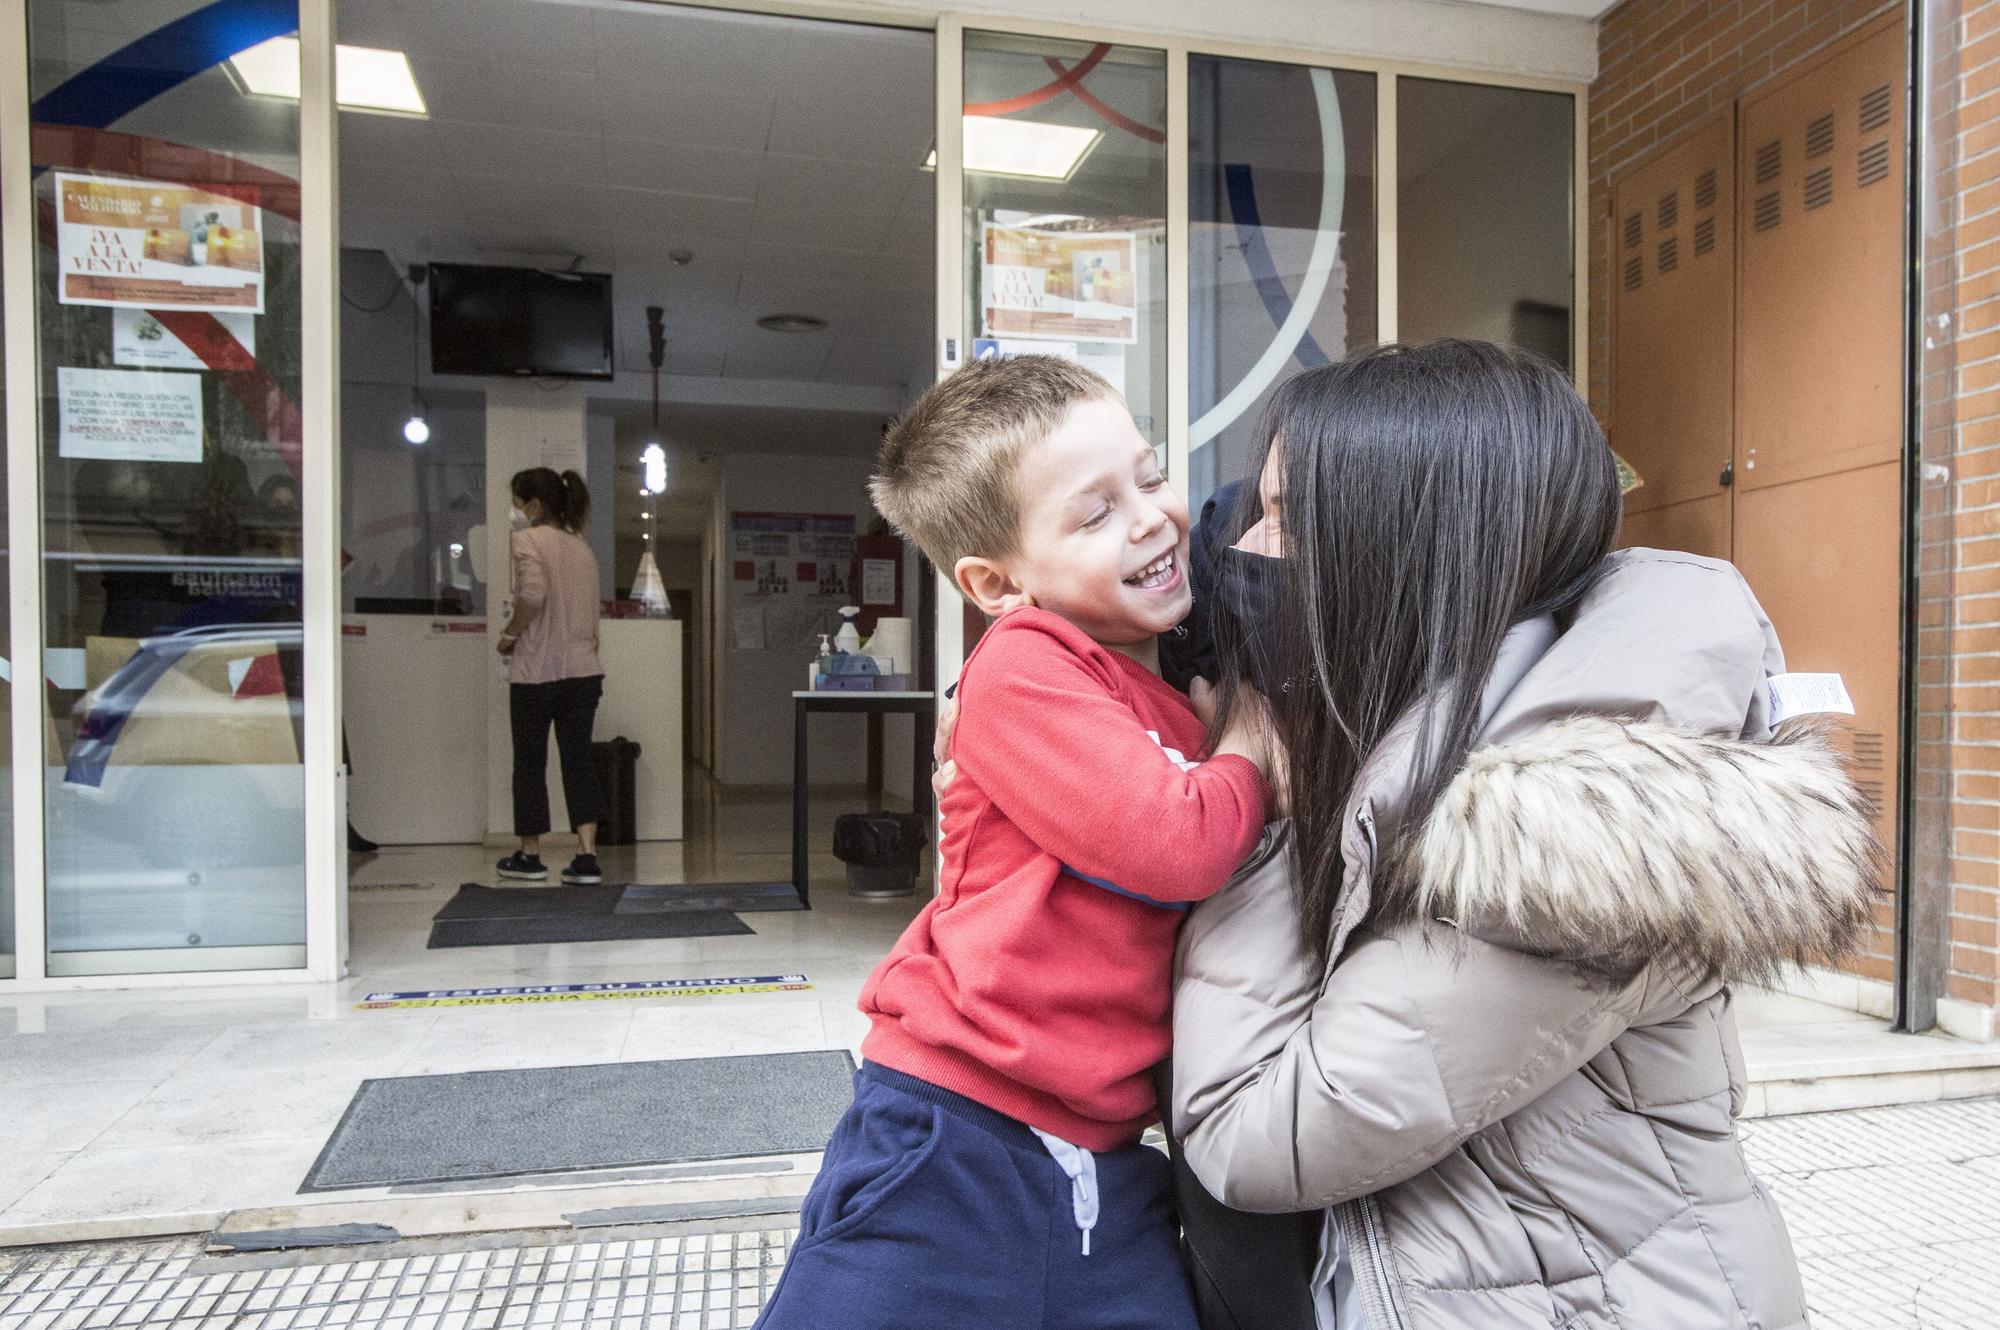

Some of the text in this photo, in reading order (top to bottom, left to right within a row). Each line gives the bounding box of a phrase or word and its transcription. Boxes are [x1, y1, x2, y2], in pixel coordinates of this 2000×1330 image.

[104, 246, 128, 259] LA
[74, 257, 142, 274] VENTA!
[427, 977, 757, 998] ESPERE SU TURNO
[459, 994, 581, 1005] DISTANCIA
